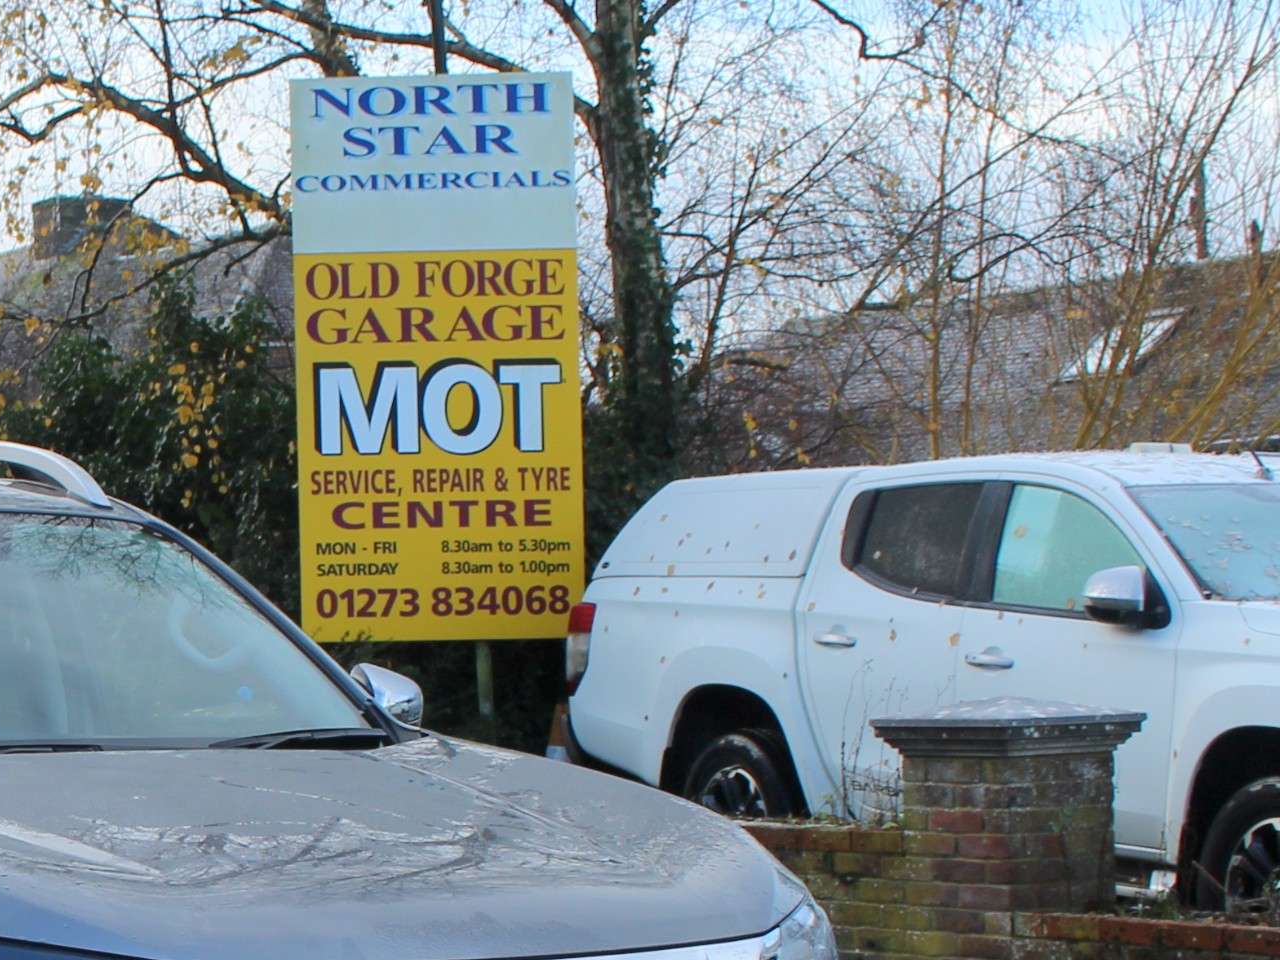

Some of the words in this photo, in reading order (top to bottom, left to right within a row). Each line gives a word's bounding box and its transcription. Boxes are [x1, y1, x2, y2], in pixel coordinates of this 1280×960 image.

[310, 82, 550, 118] NORTH
[342, 124, 519, 157] STAR
[295, 170, 571, 192] COMMERCIALS
[305, 261, 400, 301] OLD
[414, 259, 566, 297] FORGE
[305, 304, 566, 345] GARAGE
[312, 357, 563, 456] MOT
[310, 469, 402, 497] SERVICE,
[412, 468, 485, 493] REPAIR
[494, 467, 509, 492] &
[517, 466, 571, 491] TYRE
[331, 499, 553, 530] CENTRE
[315, 542, 357, 556] MON
[373, 541, 398, 554] FRI
[440, 540, 493, 553] 8.30am
[498, 541, 513, 552] to
[518, 539, 571, 555] 5.30pm
[316, 562, 399, 577] SATURDAY
[440, 562, 493, 574] 8.30am
[498, 561, 513, 573] to
[519, 561, 570, 576] 1.00pm
[316, 588, 420, 618] 01273
[431, 585, 570, 616] 834068
